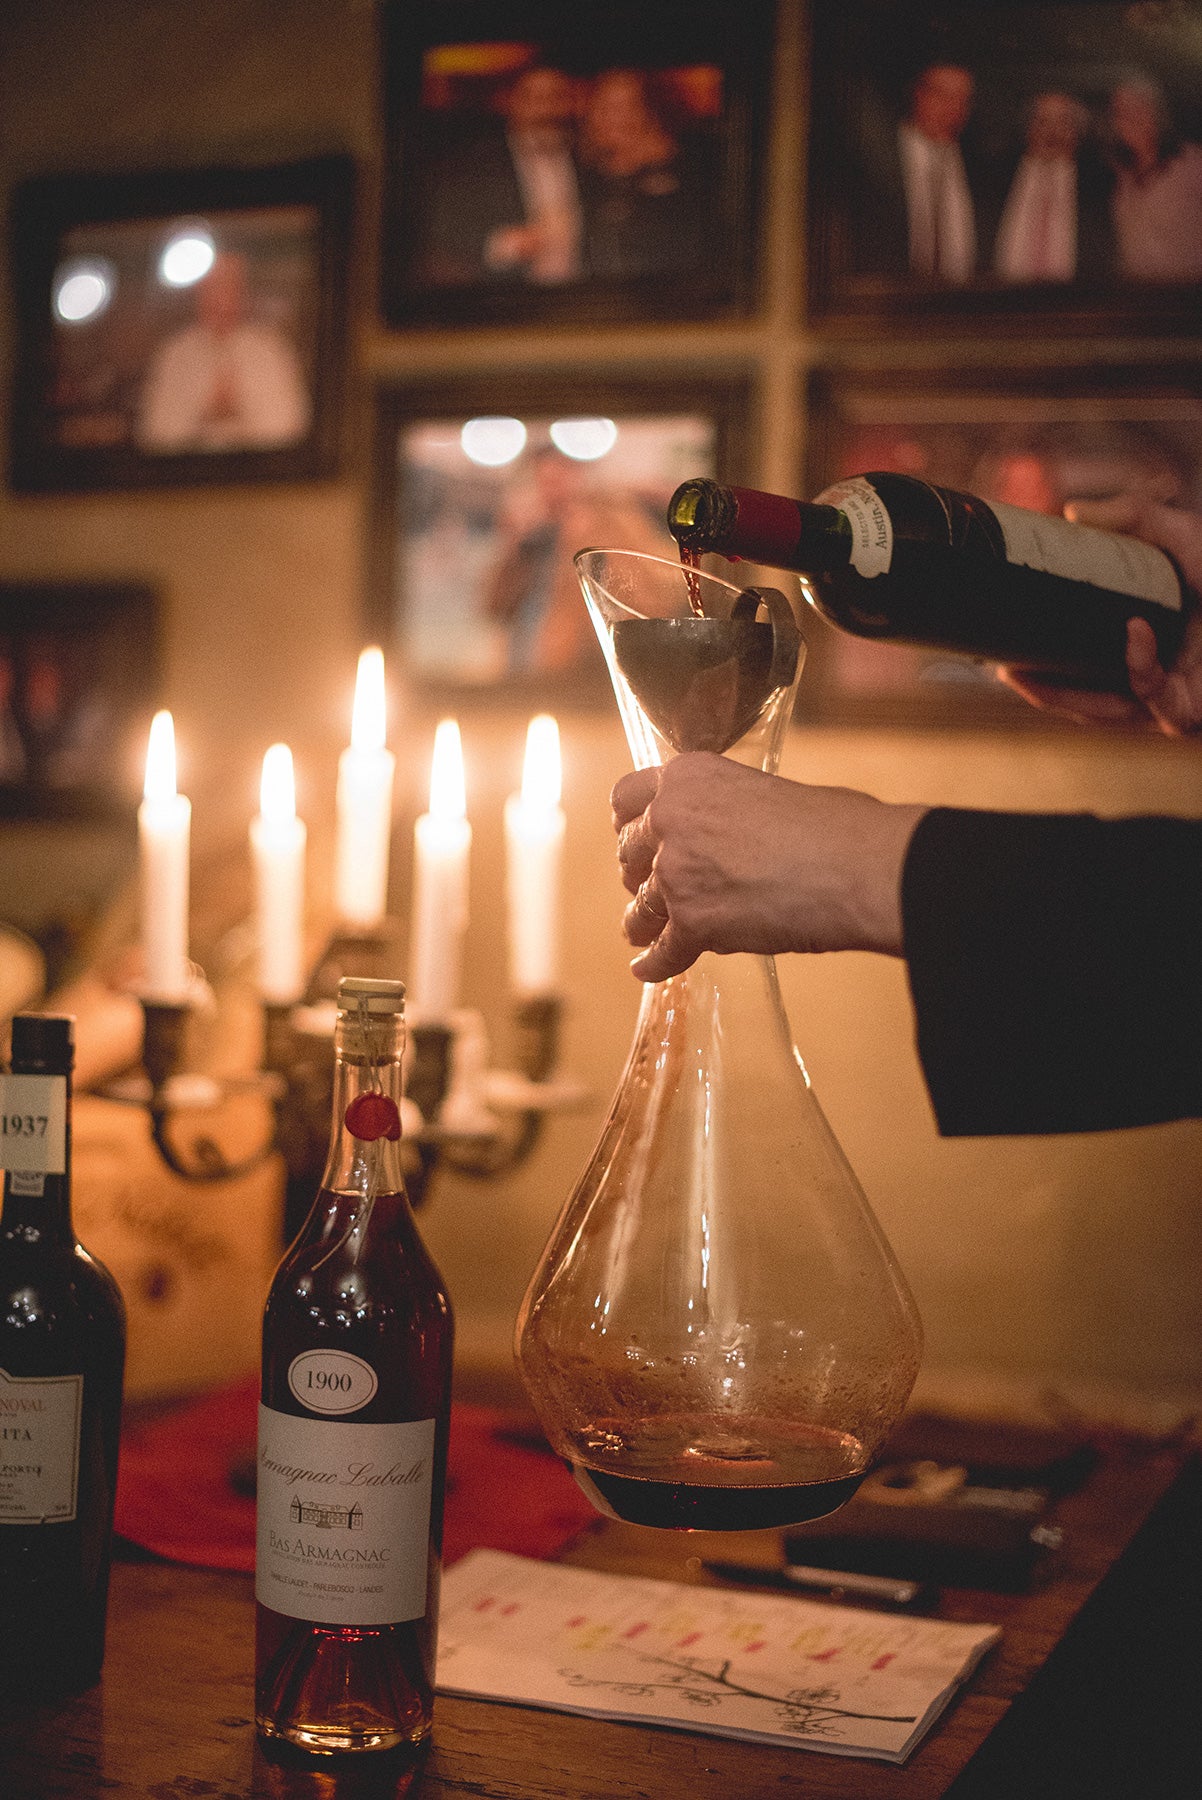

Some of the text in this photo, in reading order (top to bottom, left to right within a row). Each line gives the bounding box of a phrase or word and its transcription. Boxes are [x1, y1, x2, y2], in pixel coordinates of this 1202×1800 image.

[3, 1114, 48, 1137] 1937
[307, 1370, 352, 1393] 1900
[340, 1458, 427, 1487] Laballe
[270, 1530, 290, 1553] BAS
[292, 1538, 391, 1562] ARMAGNAC
